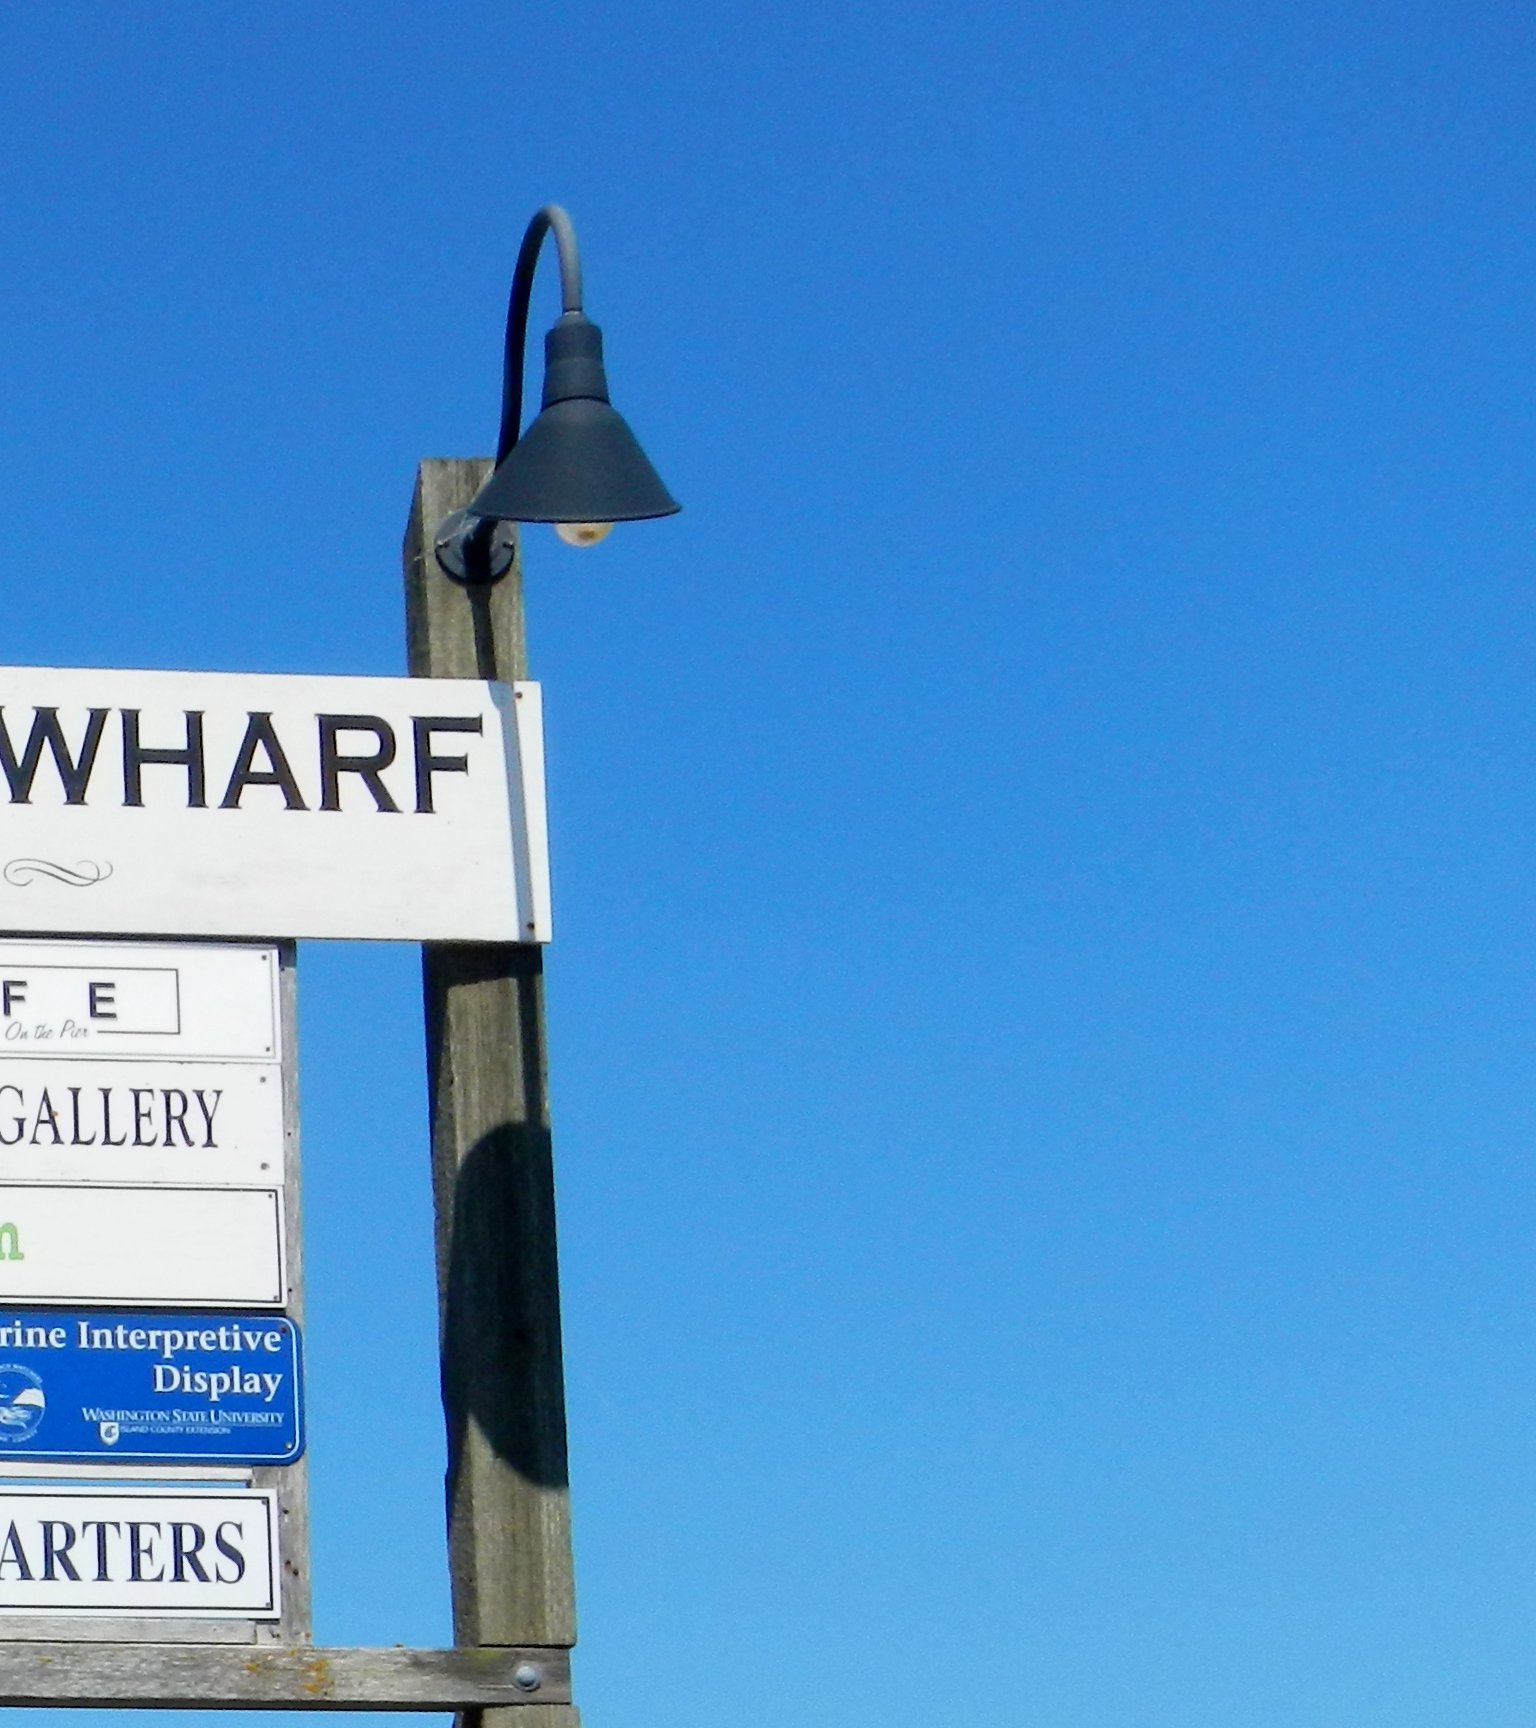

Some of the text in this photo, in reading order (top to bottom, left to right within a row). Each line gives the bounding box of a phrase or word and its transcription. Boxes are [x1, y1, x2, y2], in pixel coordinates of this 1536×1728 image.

[5, 1019, 89, 1041] On the Pier
[77, 1321, 282, 1359] Interpretive
[153, 1363, 283, 1403] Display
